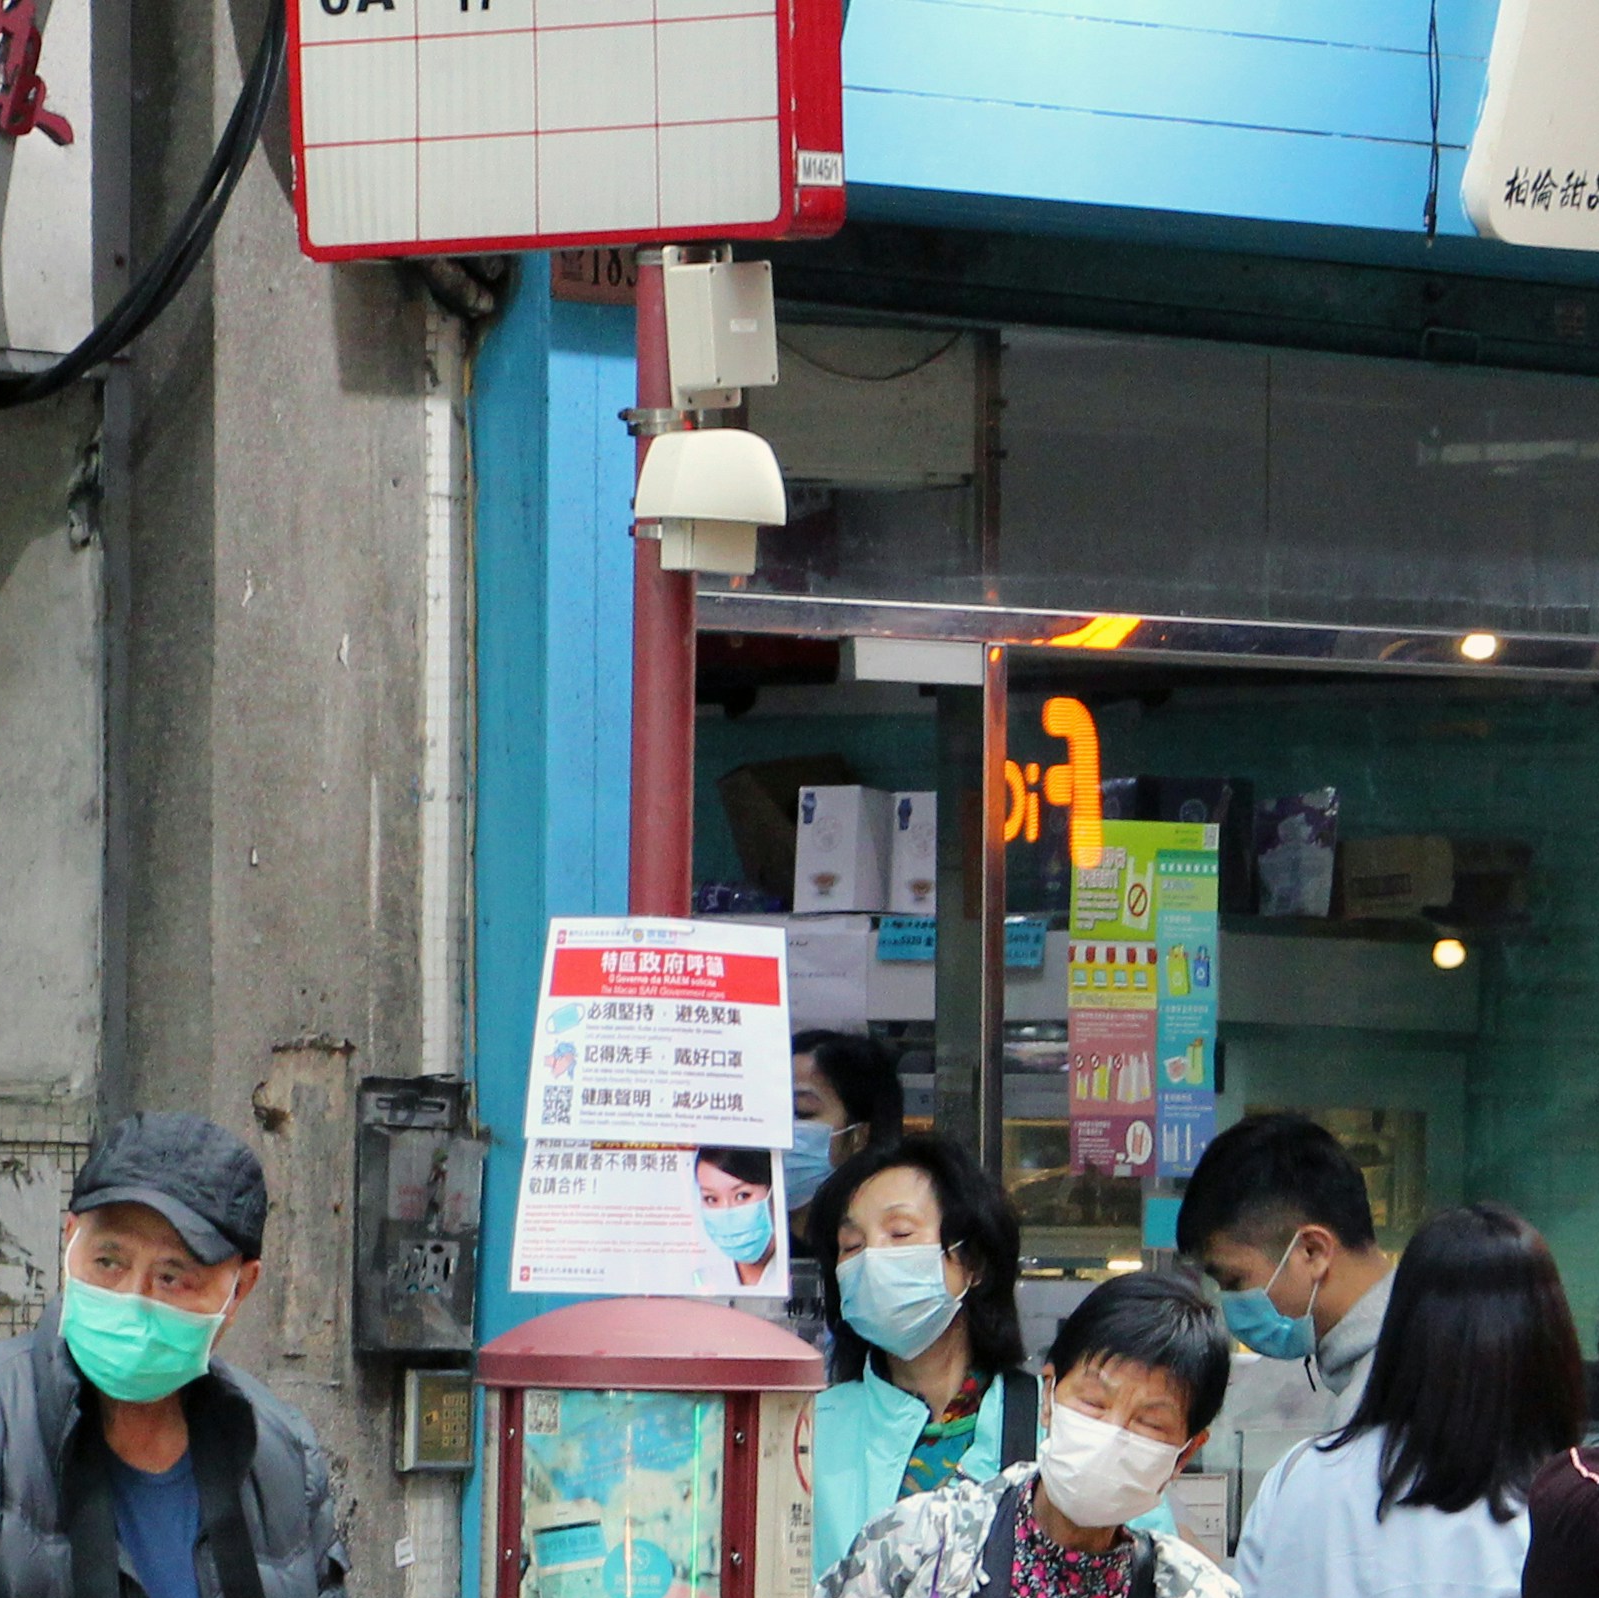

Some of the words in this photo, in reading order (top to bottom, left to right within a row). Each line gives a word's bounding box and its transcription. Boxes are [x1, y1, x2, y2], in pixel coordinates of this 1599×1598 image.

[802, 156, 841, 183] M145/1
[615, 975, 648, 985] Governo
[663, 976, 689, 985] RAEM
